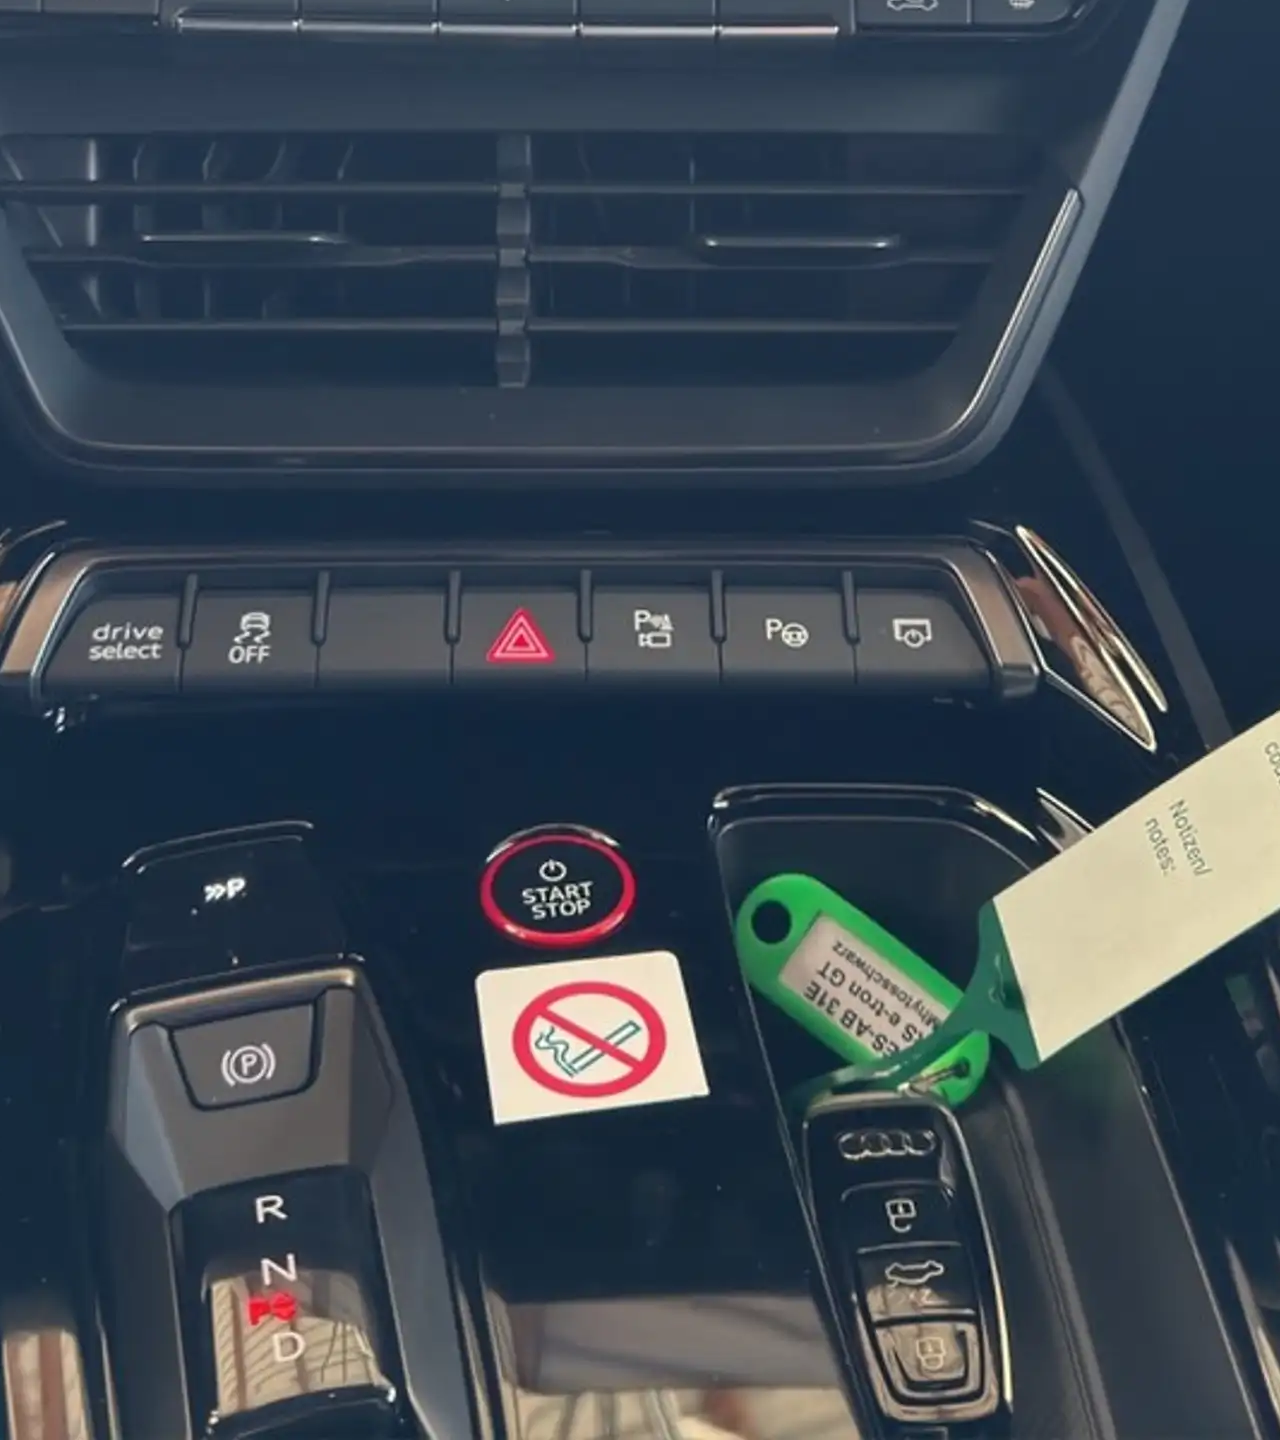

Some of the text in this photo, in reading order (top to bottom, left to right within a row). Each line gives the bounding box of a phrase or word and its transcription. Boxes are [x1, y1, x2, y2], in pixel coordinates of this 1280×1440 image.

[91, 622, 165, 643] drive
[88, 641, 164, 661] select
[227, 644, 272, 665] OFF
[1144, 817, 1177, 877] notes:
[1167, 798, 1213, 878] Notizen/
[520, 879, 594, 907] START
[531, 898, 592, 921] STOP
[817, 960, 848, 988] GT
[803, 979, 842, 1018] 31E
[848, 982, 902, 1027] e-tron
[254, 1193, 289, 1224] R
[260, 1252, 298, 1286] N
[272, 1331, 307, 1362] D
